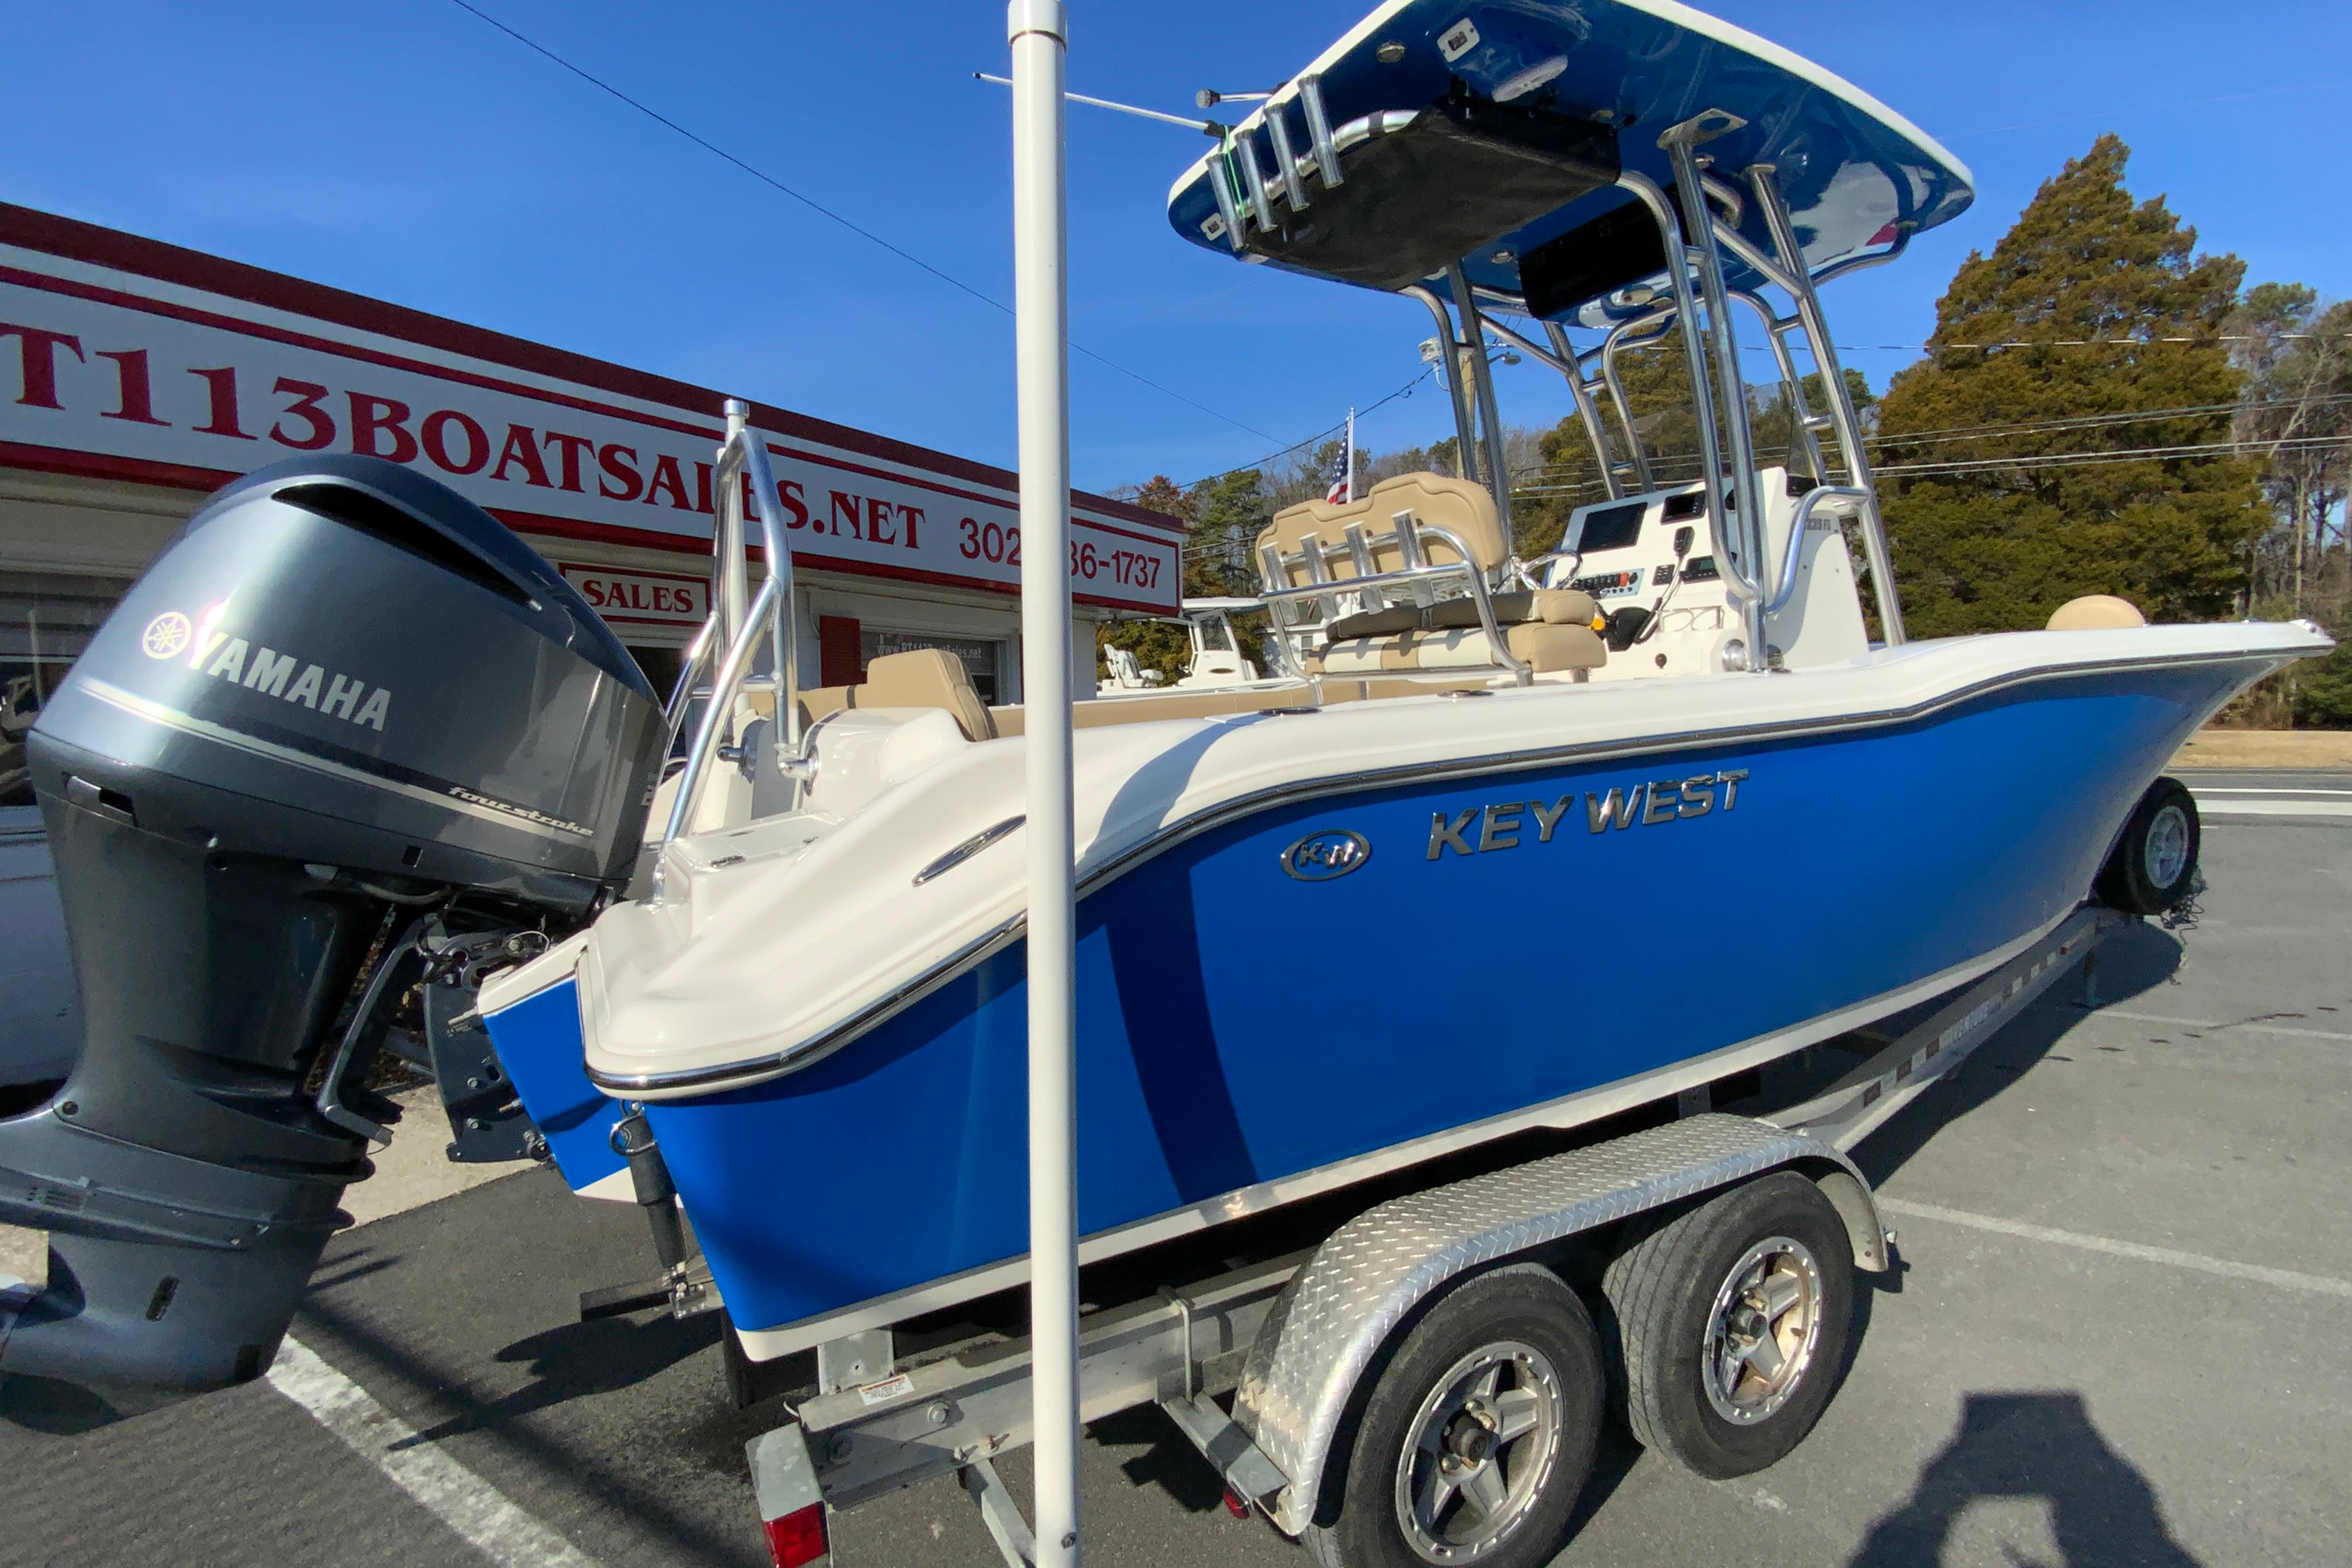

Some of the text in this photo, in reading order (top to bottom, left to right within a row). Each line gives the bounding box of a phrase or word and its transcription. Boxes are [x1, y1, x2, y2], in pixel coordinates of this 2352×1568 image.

[583, 579, 694, 613] SALES
[188, 626, 391, 732] YAMAHA
[1426, 768, 1749, 861] KEY WEST
[1299, 839, 1356, 869] KW
